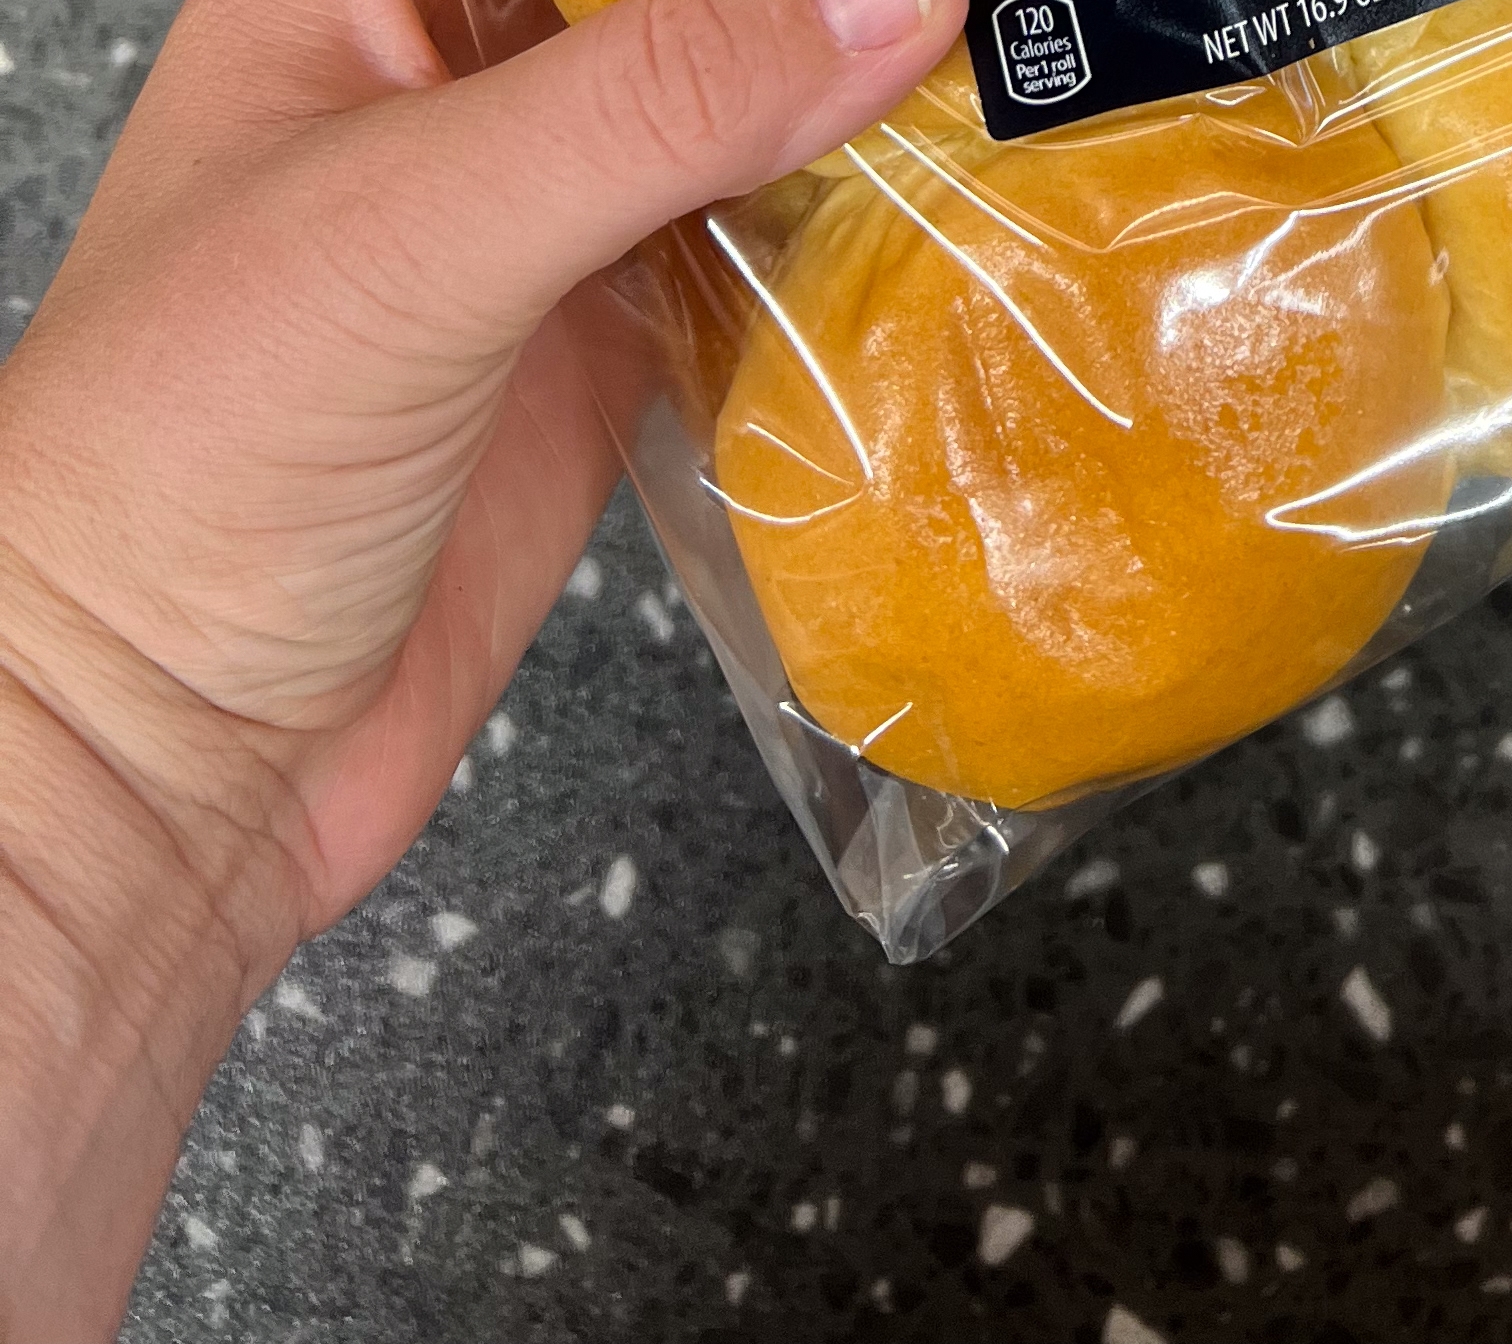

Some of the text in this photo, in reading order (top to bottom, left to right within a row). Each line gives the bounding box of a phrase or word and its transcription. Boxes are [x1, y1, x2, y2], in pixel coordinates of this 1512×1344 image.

[1014, 4, 1055, 37] 120
[1202, 18, 1252, 65] NET
[1251, 1, 1293, 47] WT
[1009, 36, 1073, 62] Calories
[1015, 62, 1040, 81] Per
[1050, 52, 1078, 76] roll
[1022, 70, 1078, 95] serving
